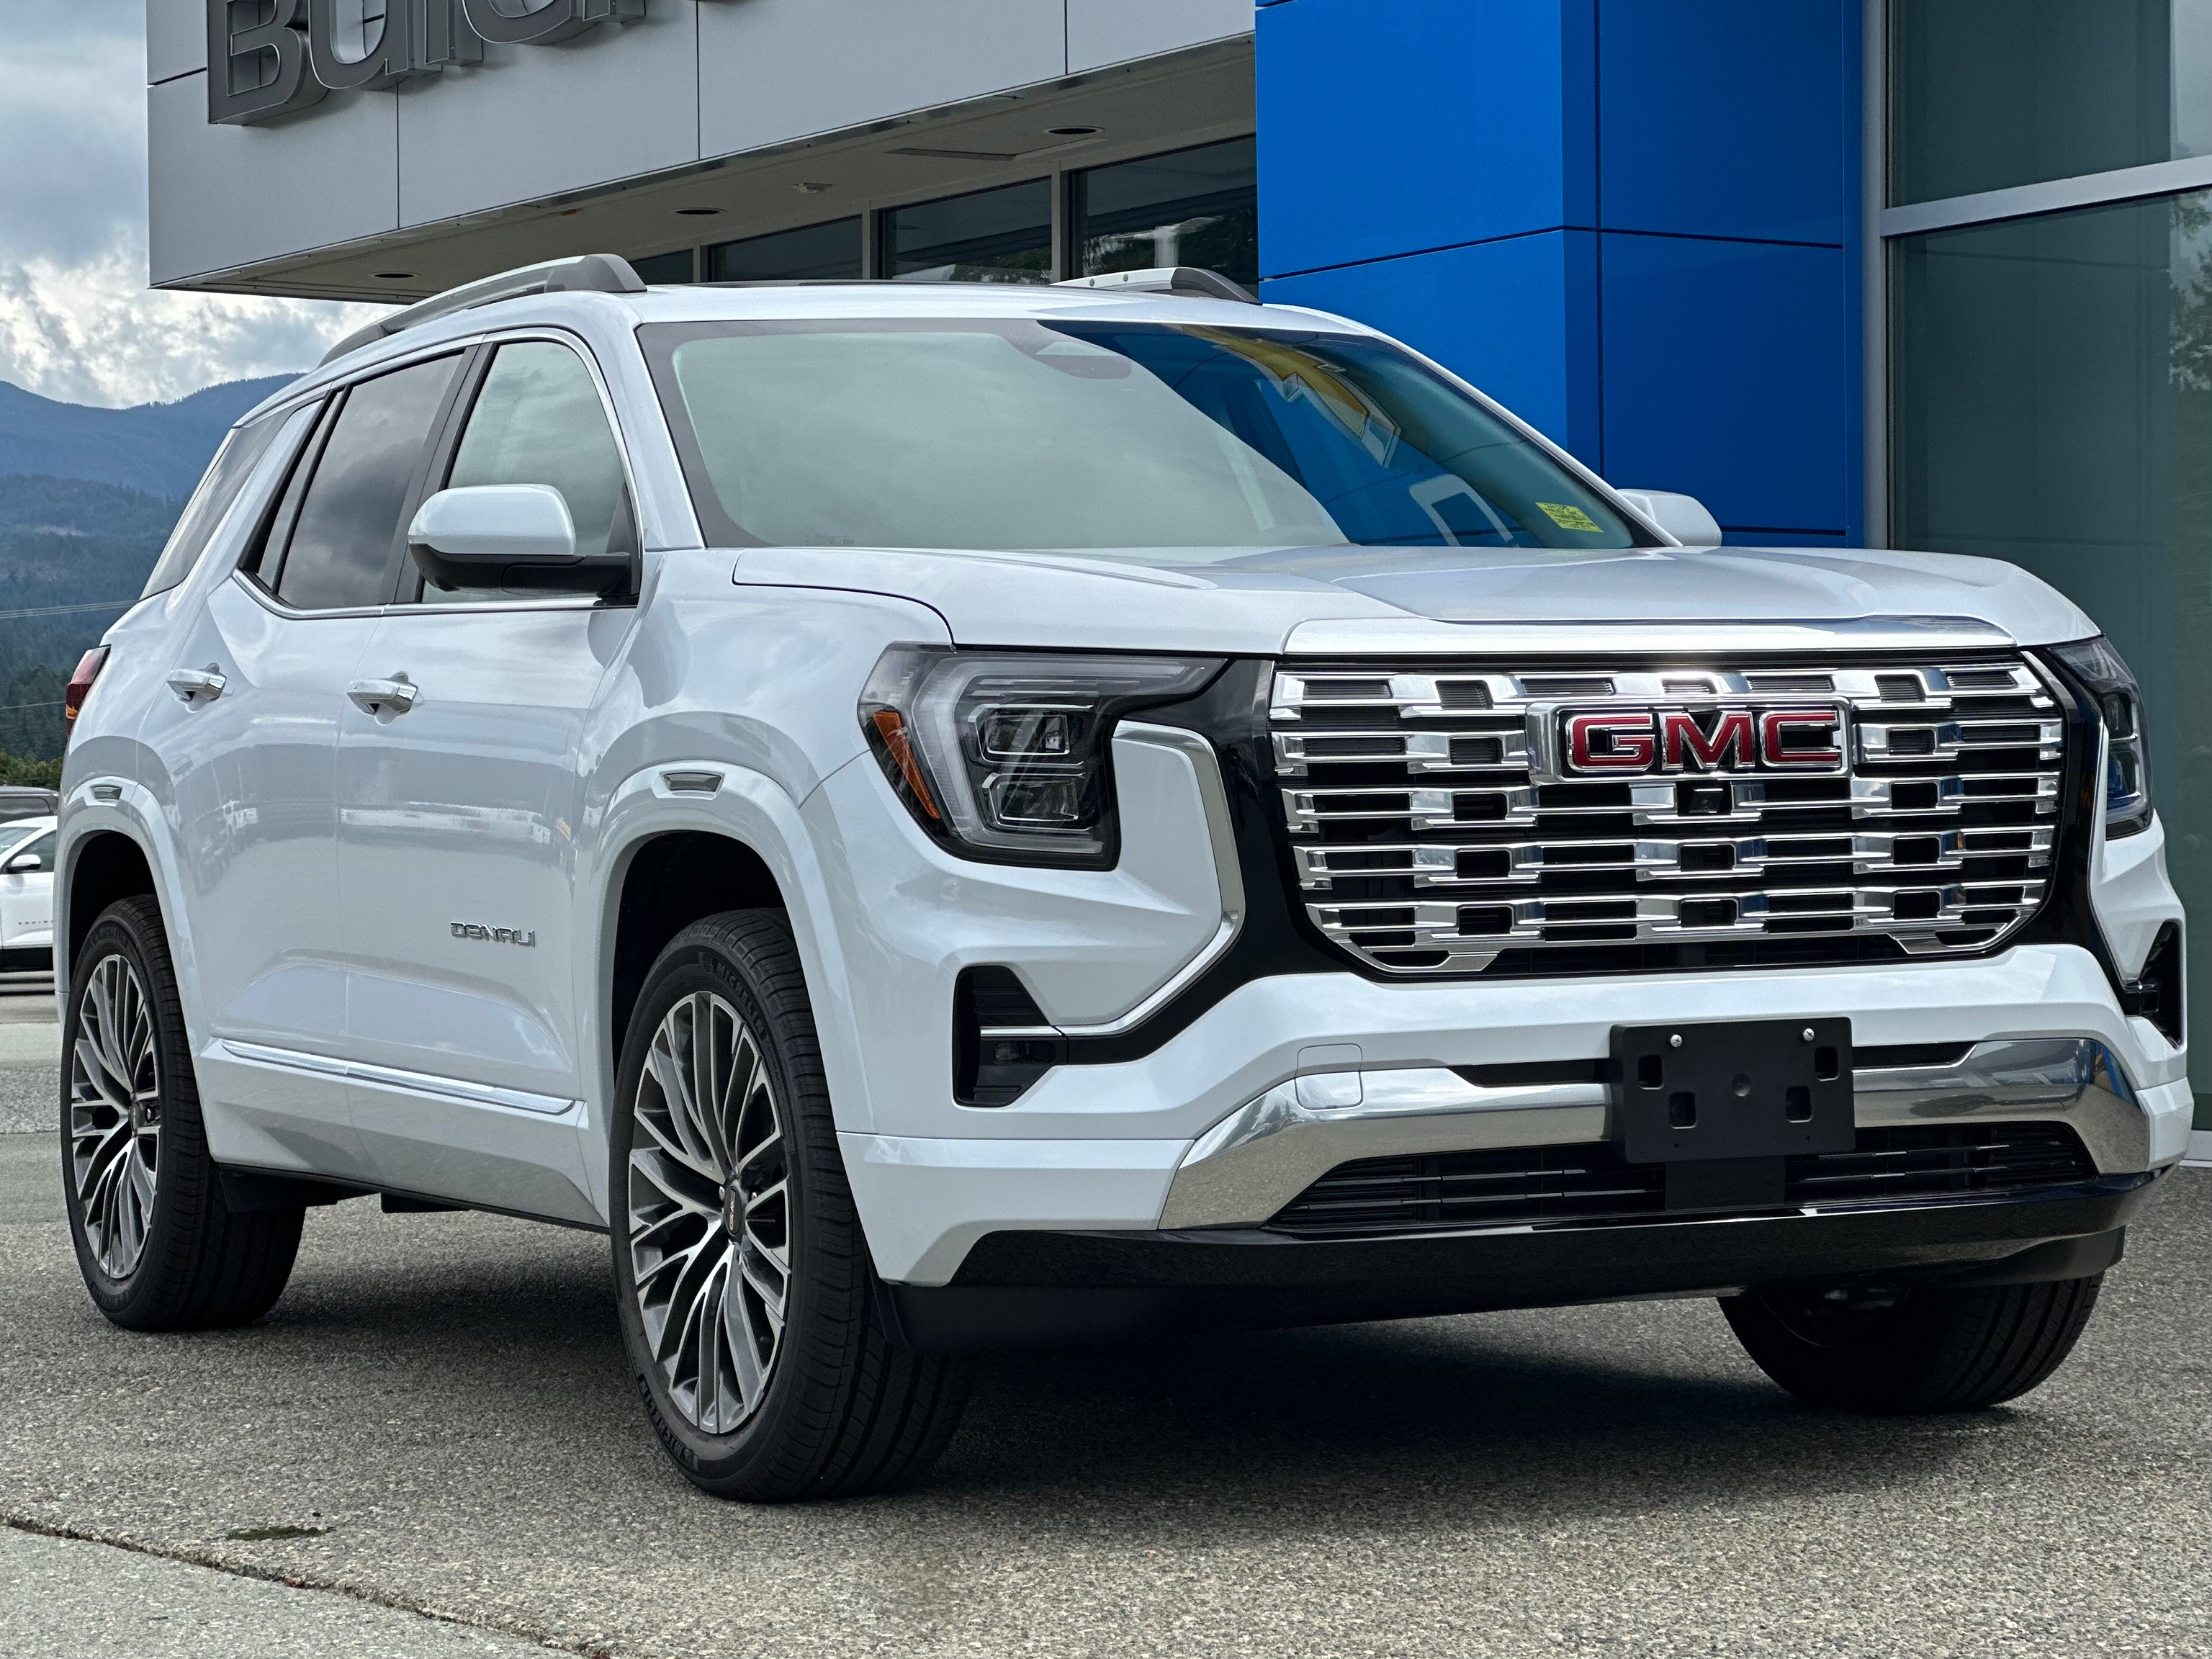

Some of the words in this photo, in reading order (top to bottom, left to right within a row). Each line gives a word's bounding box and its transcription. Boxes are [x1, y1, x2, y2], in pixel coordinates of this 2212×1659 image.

[1566, 709, 1842, 773] GMC
[450, 921, 536, 947] DENALI
[716, 961, 765, 1035] MICHELIN
[639, 1379, 683, 1457] MICHELIN
